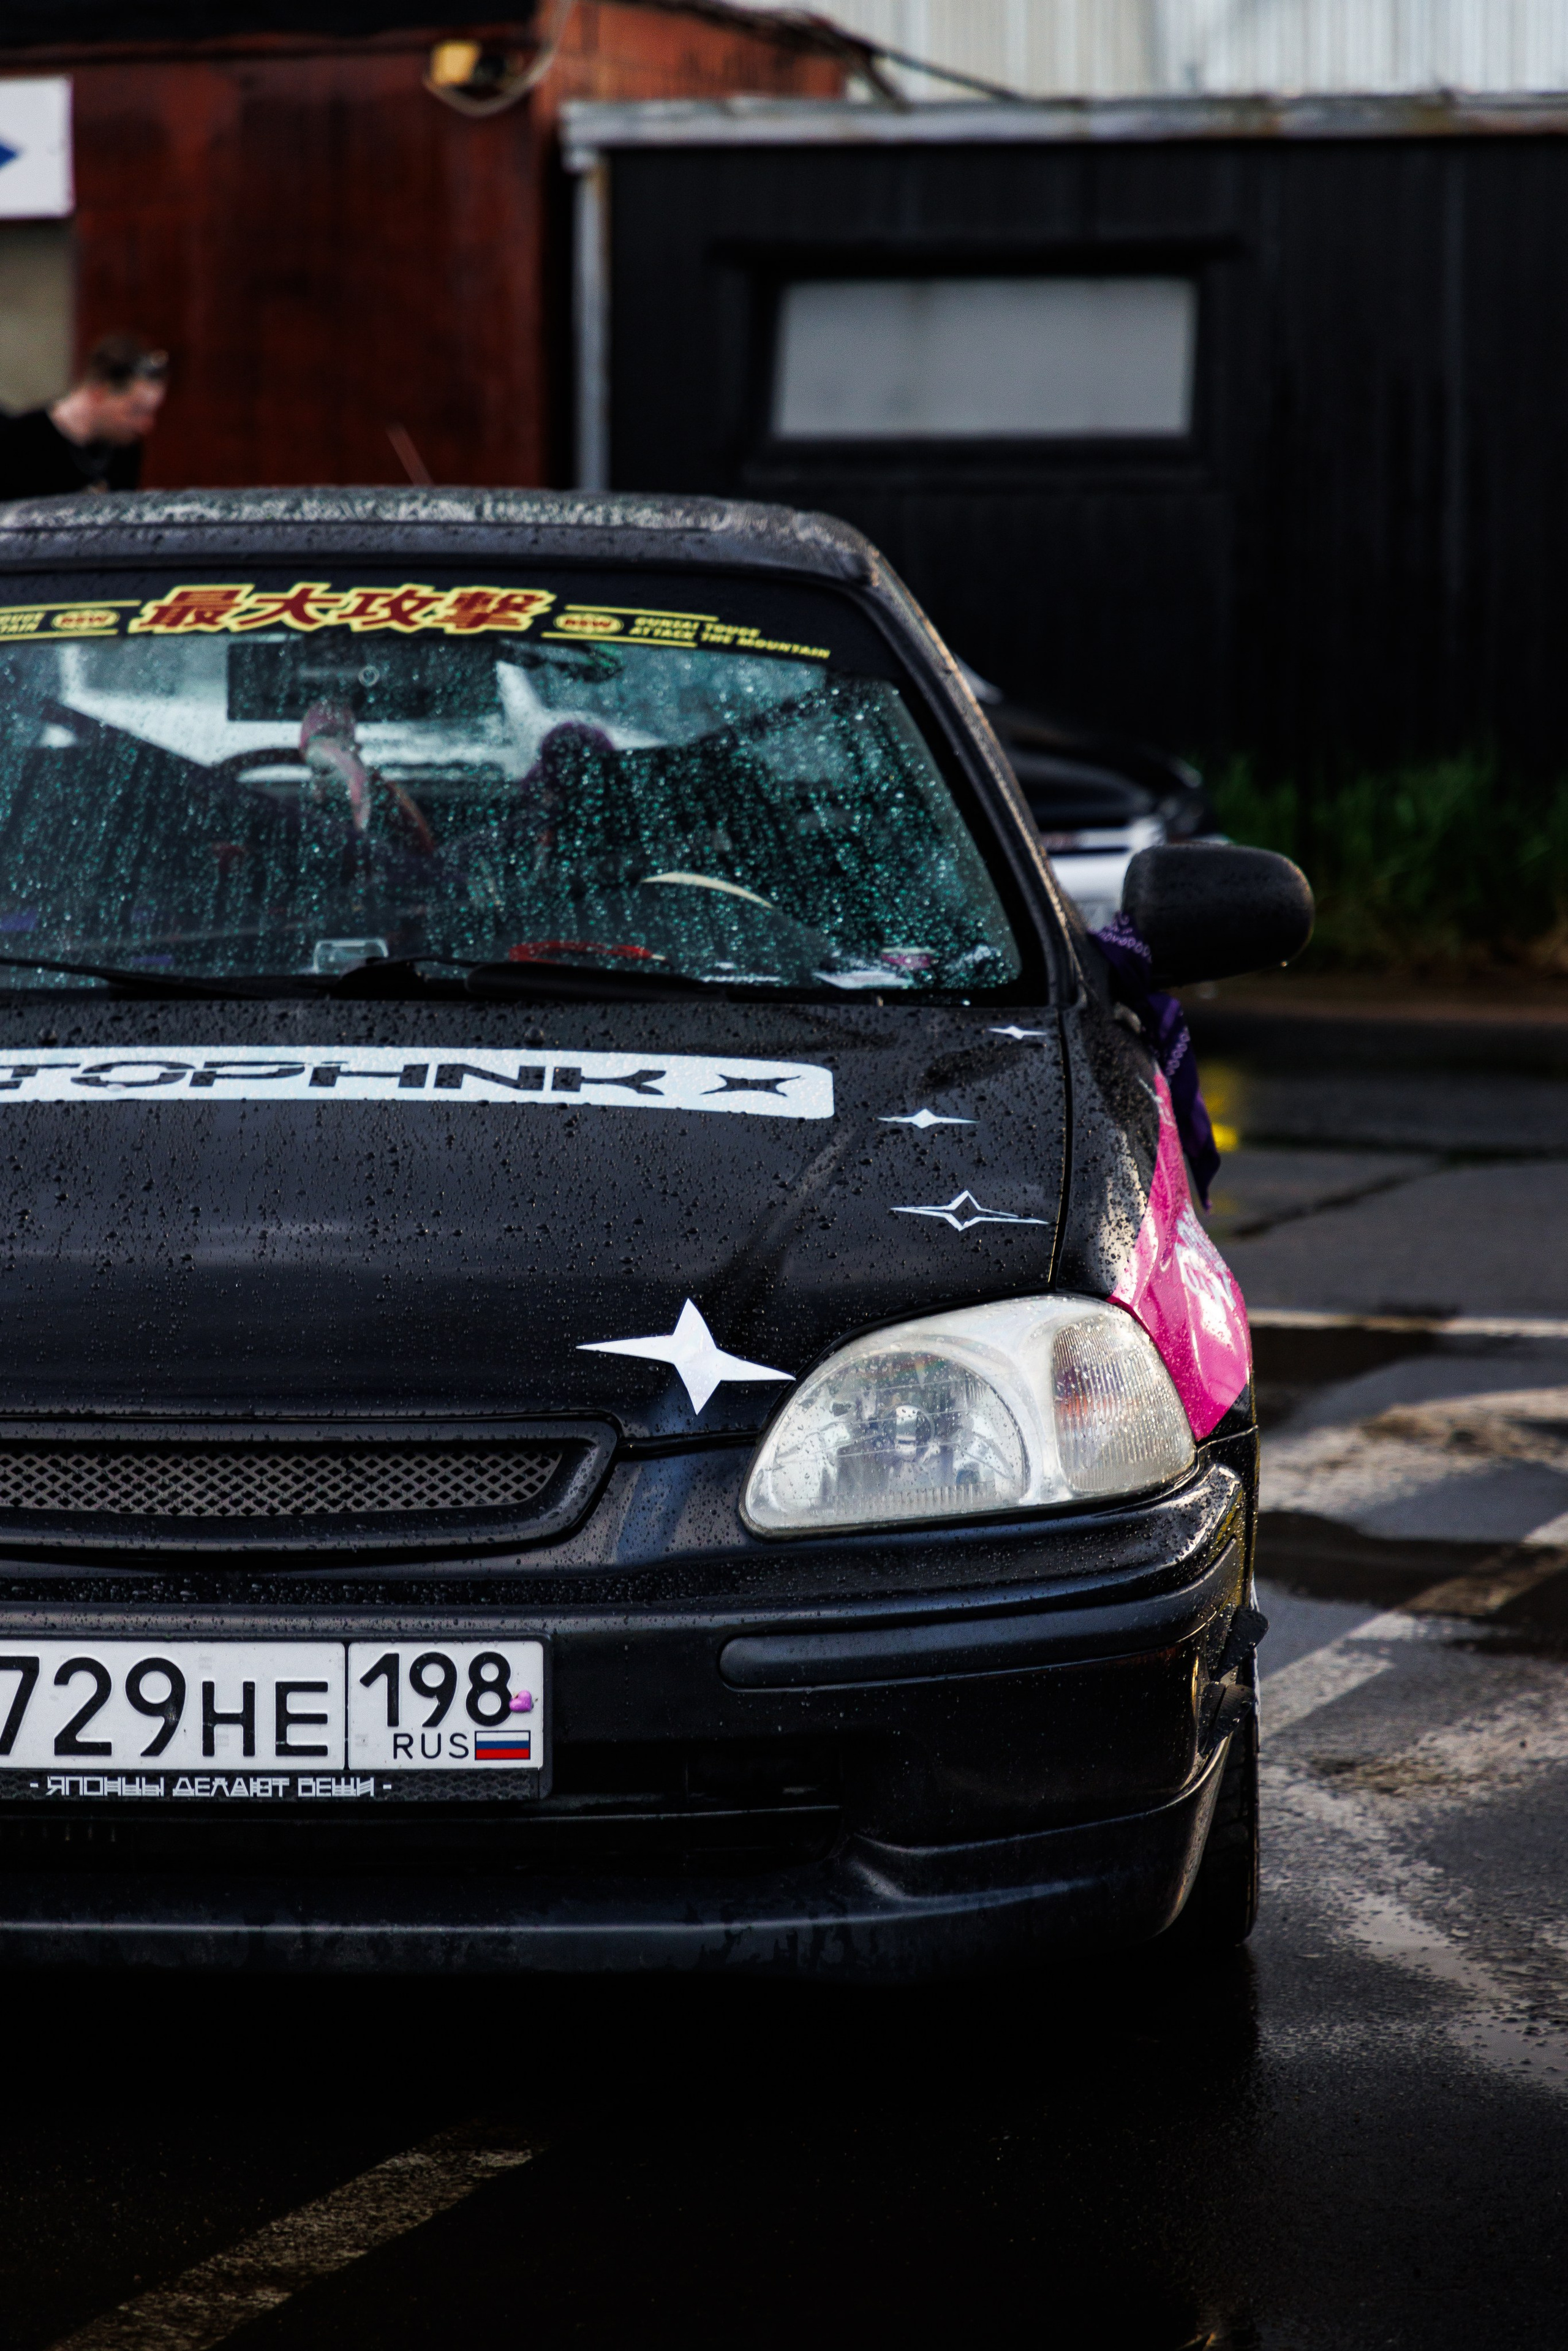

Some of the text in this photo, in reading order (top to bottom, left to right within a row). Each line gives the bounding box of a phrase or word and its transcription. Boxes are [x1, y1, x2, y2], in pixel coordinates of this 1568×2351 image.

[629, 625, 832, 659] ATTACK THE MOUNTAIN
[704, 622, 761, 639] TOUGE
[359, 1651, 513, 1729] 198
[393, 1732, 469, 1760] RUS
[46, 1776, 164, 1797] ЯПОНЦЫ
[173, 1776, 290, 1797] ДЕЛАЮТ
[298, 1776, 374, 1798] ВЕЩИ
